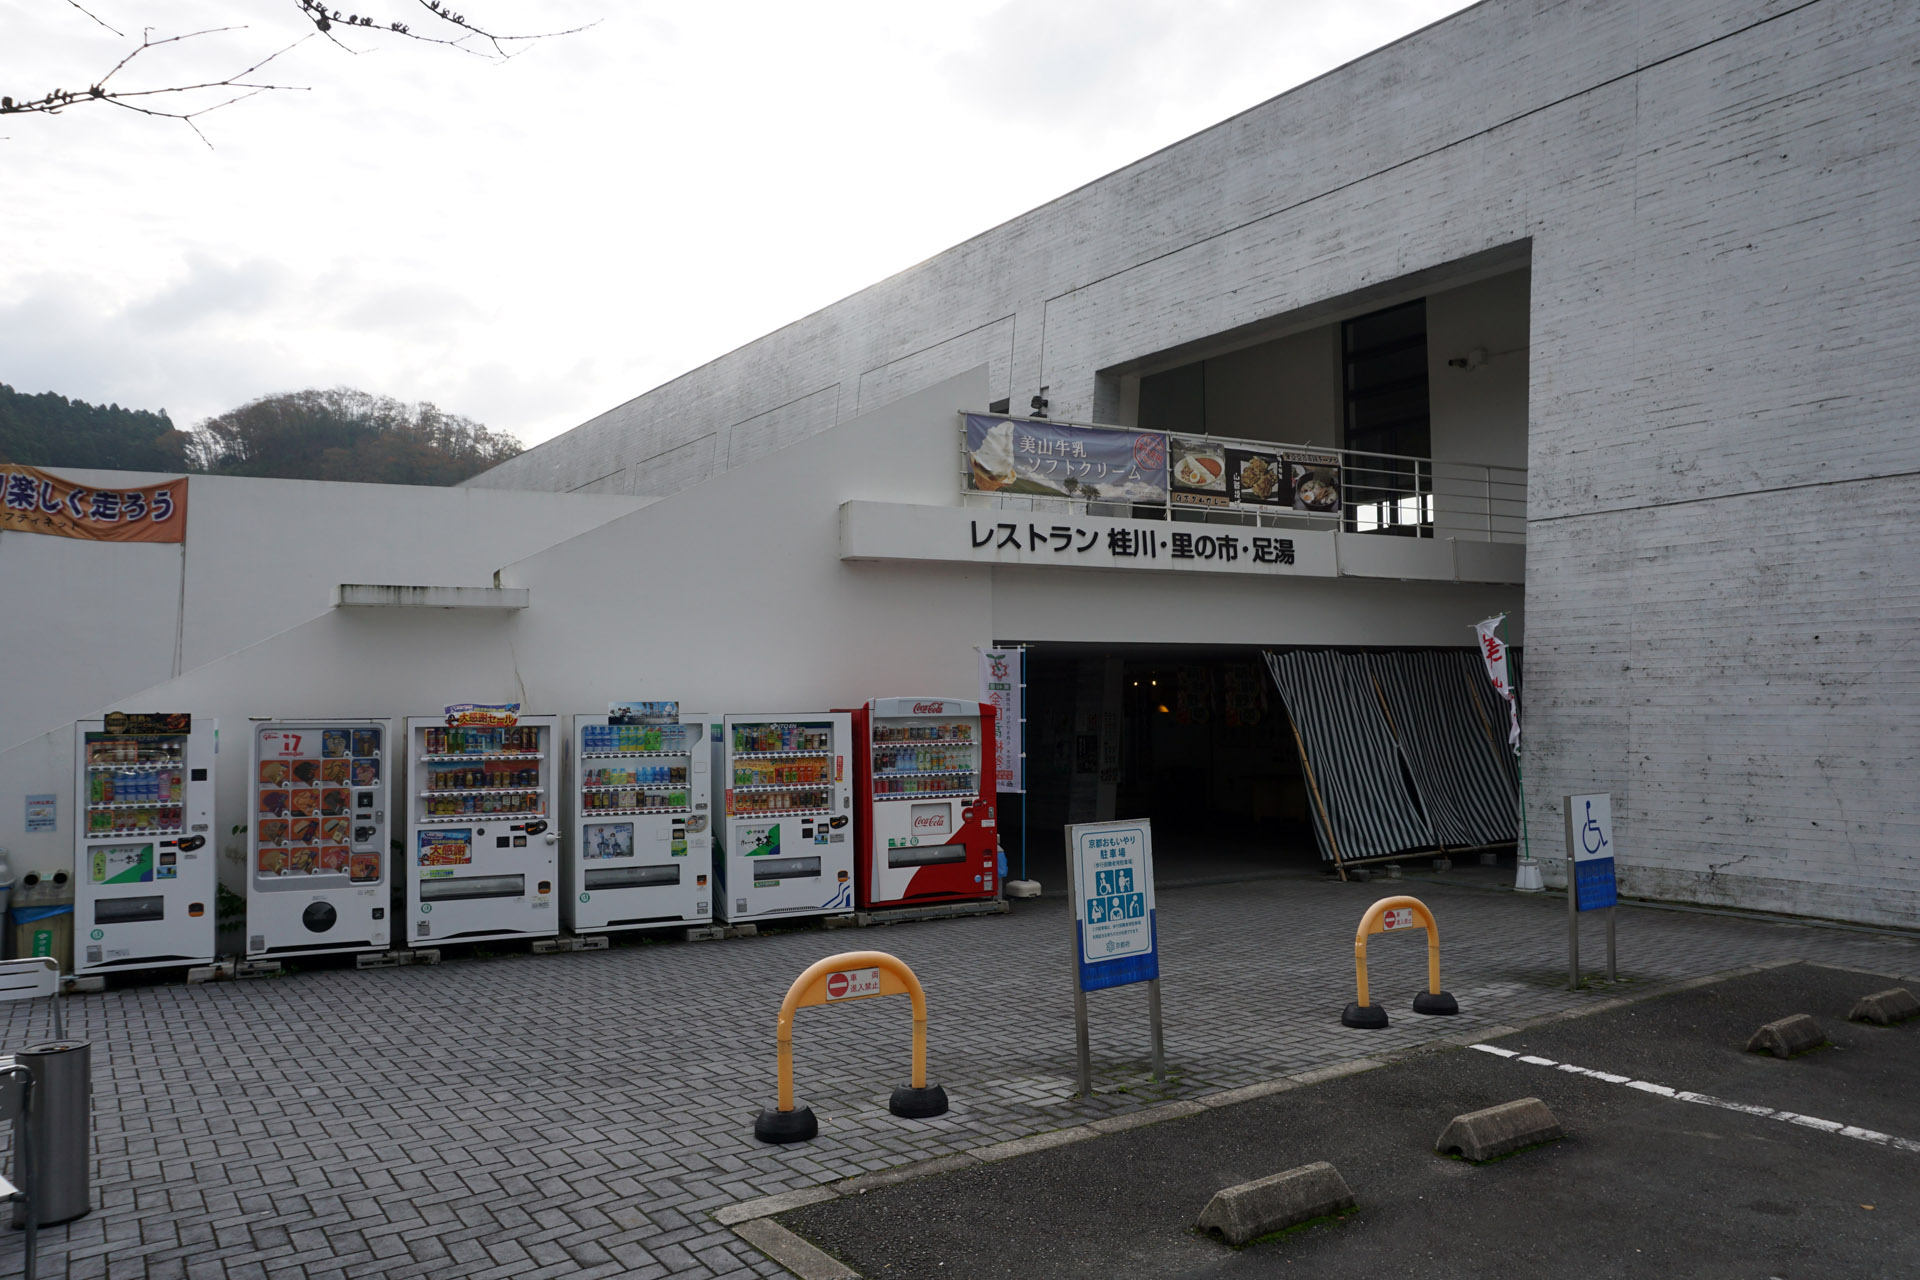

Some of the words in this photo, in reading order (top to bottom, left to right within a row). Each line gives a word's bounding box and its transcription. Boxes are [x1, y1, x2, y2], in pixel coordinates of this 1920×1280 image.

[1019, 435, 1087, 458] 美山牛乳
[1028, 457, 1141, 481] ソフトクリーム
[0, 472, 174, 523] 楽しく走ろう
[0, 511, 79, 530] フティネット
[971, 520, 1099, 553] レストラン
[1108, 527, 1295, 565] 桂川・里の市・足湯
[1089, 836, 1135, 848] 京都おもいやり
[1100, 847, 1126, 860] 駐車場
[851, 982, 878, 992] 進入禁止
